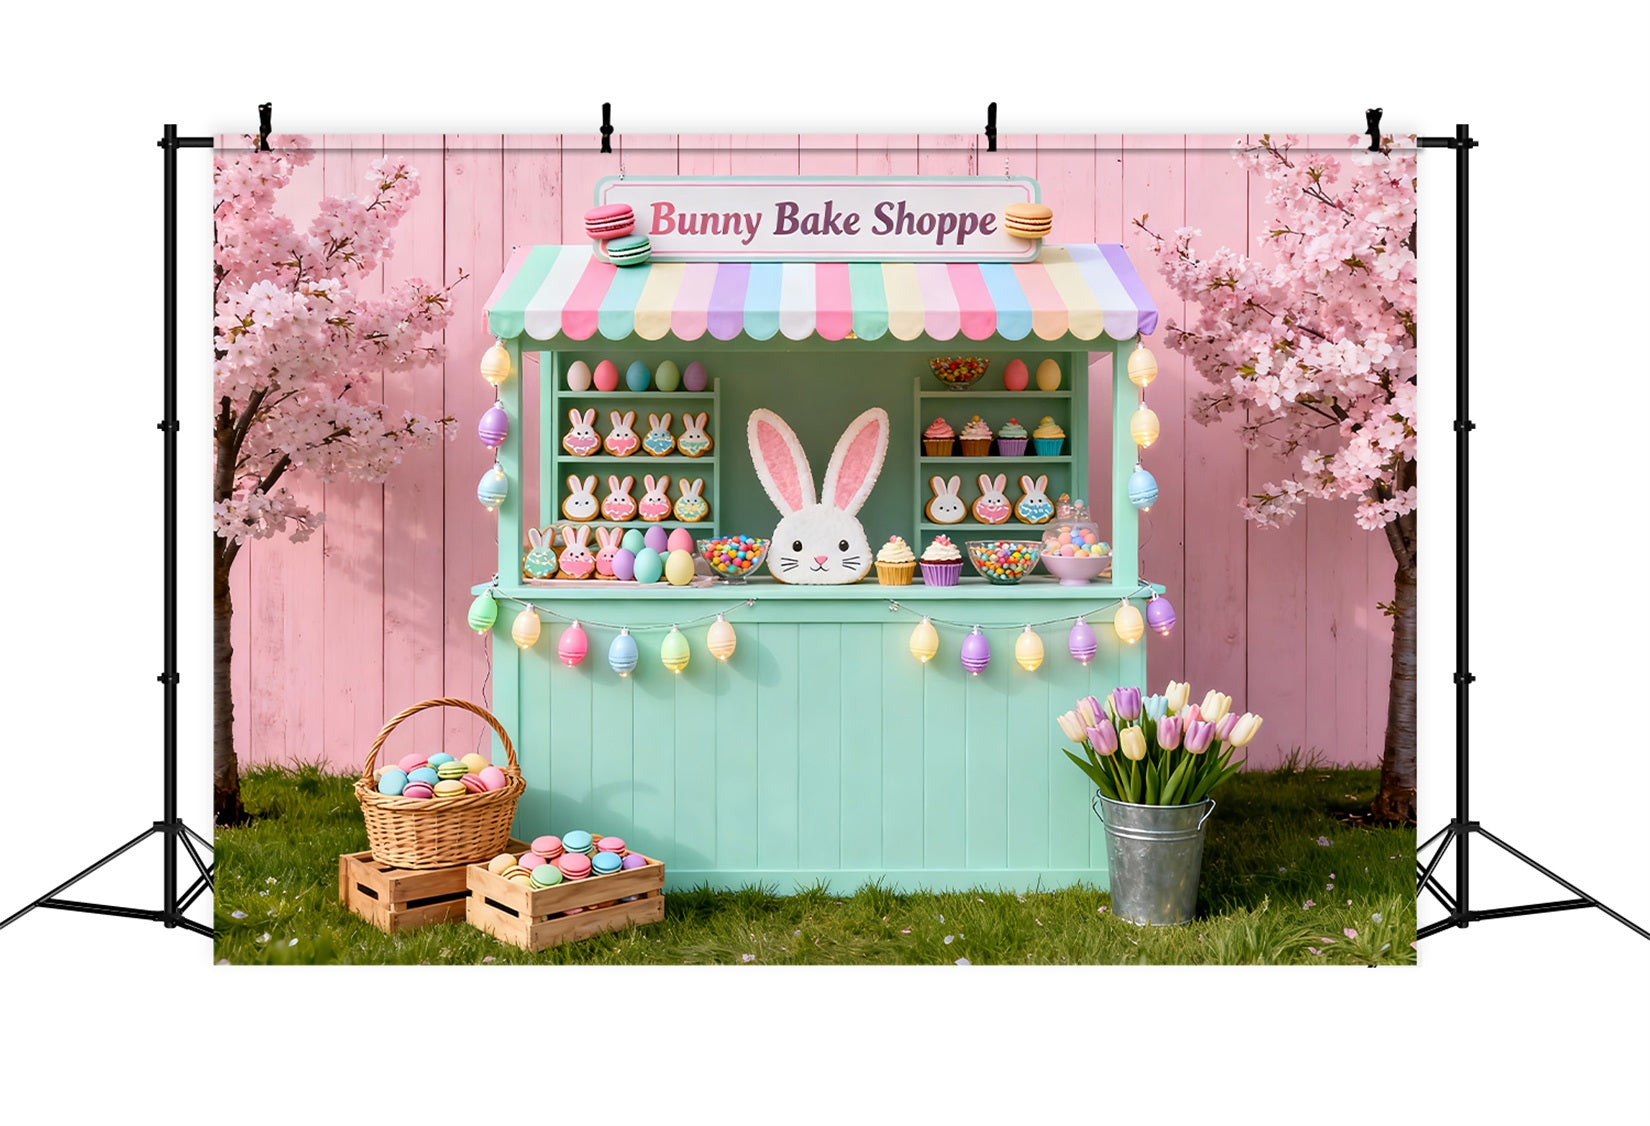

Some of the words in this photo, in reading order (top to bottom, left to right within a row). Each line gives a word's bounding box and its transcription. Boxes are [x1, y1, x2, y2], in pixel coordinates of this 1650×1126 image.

[648, 201, 762, 245] Bunny
[773, 200, 860, 236] Bake
[872, 200, 997, 246] Shoppe
